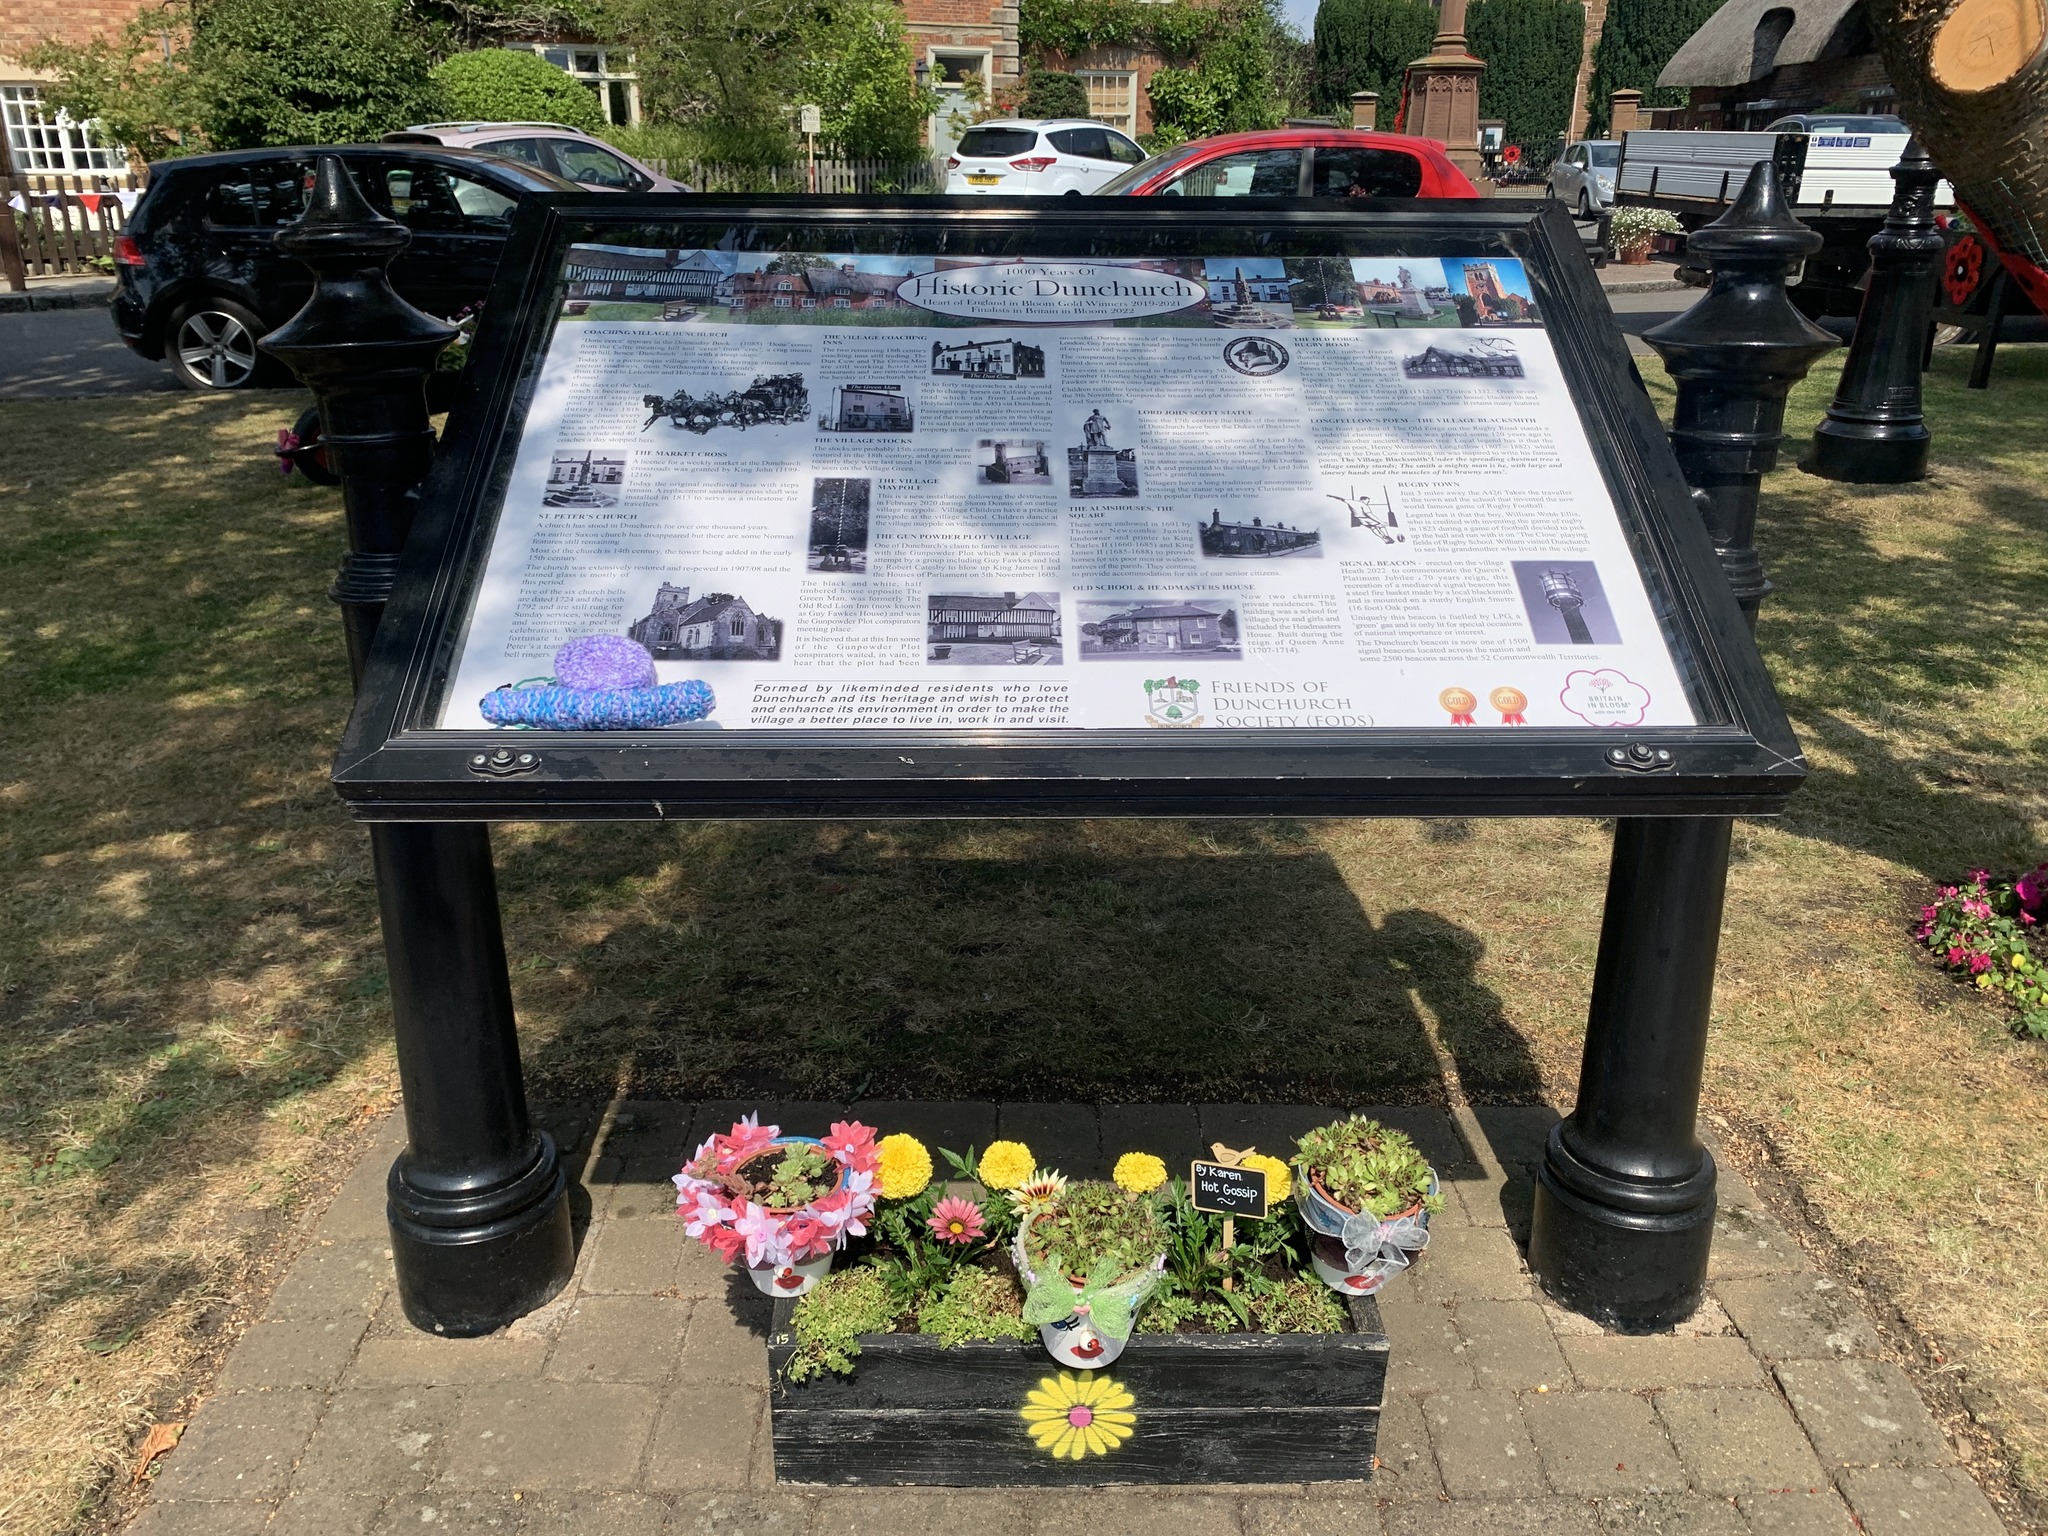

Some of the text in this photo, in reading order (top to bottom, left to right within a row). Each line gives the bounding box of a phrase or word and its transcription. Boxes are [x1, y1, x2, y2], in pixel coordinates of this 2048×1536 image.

[1039, 268, 1074, 276] Years
[914, 279, 1193, 297] Historic Dunchurch
[966, 299, 1005, 308] England
[753, 684, 1068, 694] Formed by likeminded residents who love
[1211, 680, 1327, 693] FRIENDS OF
[752, 694, 1068, 704] Dunchurch and its heritage and wish to protect
[1213, 698, 1351, 710] DUNCHURCH
[1447, 696, 1468, 705] GOLD
[1498, 696, 1519, 705] GOLD
[750, 704, 1069, 713] and enhance its environment in order to make the
[750, 715, 794, 726] village
[809, 715, 849, 724] better
[852, 715, 888, 726] place
[892, 715, 905, 724] to
[909, 715, 932, 724] live
[936, 715, 952, 726] in,
[958, 715, 989, 724] work
[993, 715, 1005, 724] in
[1009, 715, 1033, 724] and
[1038, 715, 1068, 724] visit.
[1215, 714, 1374, 727] SOCIETY (FODS)
[1196, 1164, 1206, 1176] By
[1201, 1180, 1258, 1203] Hot Gossip
[776, 1334, 789, 1344] 15
